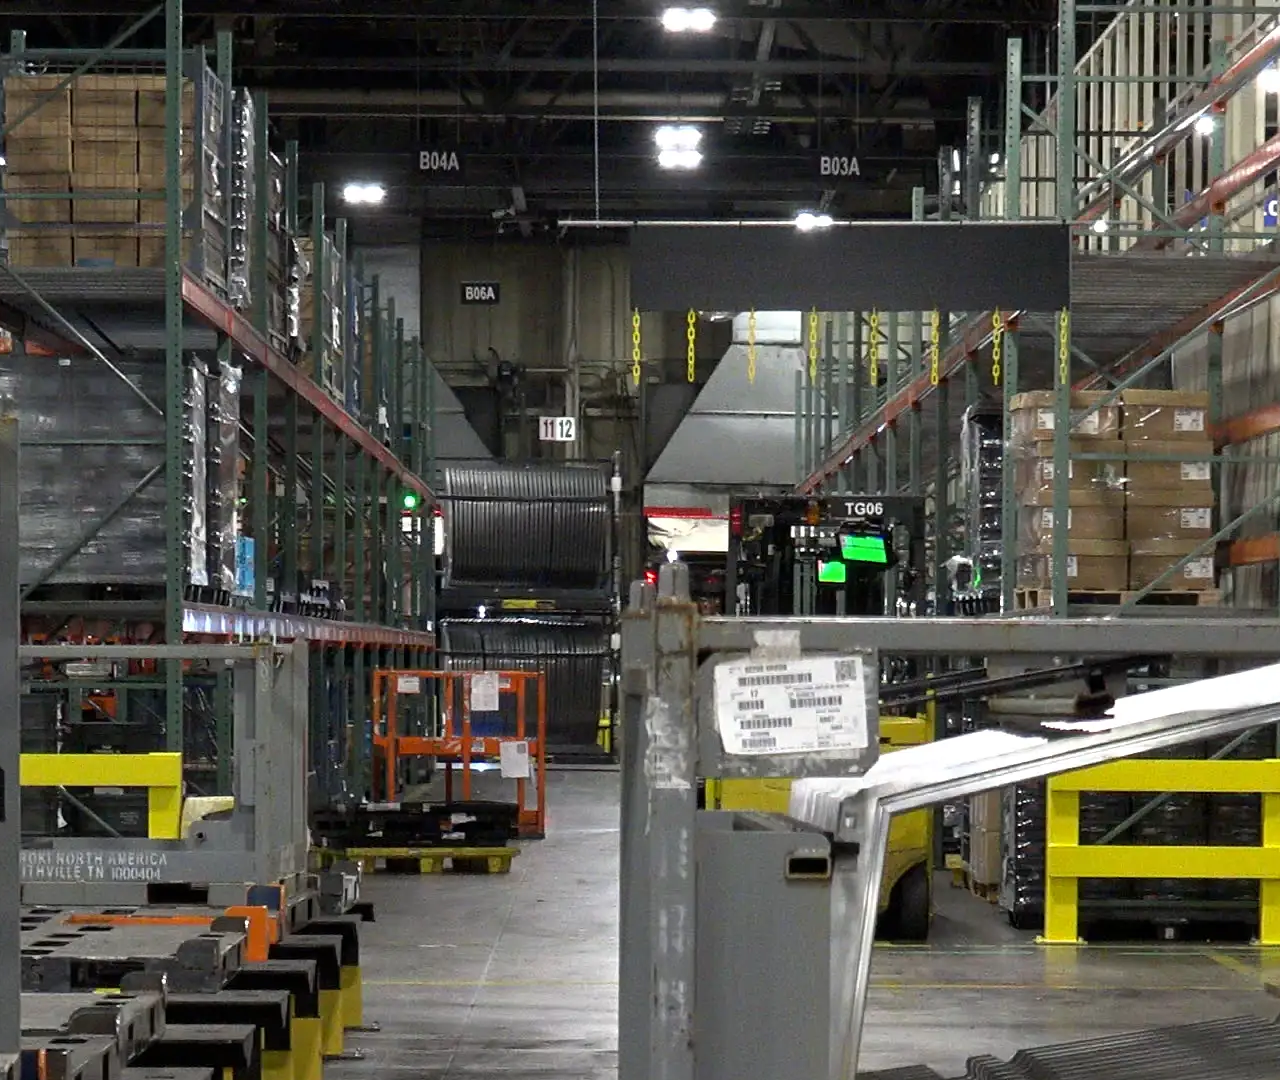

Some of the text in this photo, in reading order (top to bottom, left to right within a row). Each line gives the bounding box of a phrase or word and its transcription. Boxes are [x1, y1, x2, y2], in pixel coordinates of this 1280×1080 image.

[419, 152, 459, 171] B04A
[820, 156, 860, 176] B03A
[465, 285, 496, 301] B06A
[542, 418, 572, 439] 11 12
[845, 501, 884, 516] TG06
[56, 852, 104, 864] NORTH
[108, 853, 168, 865] AMERICA
[88, 866, 104, 879] TN
